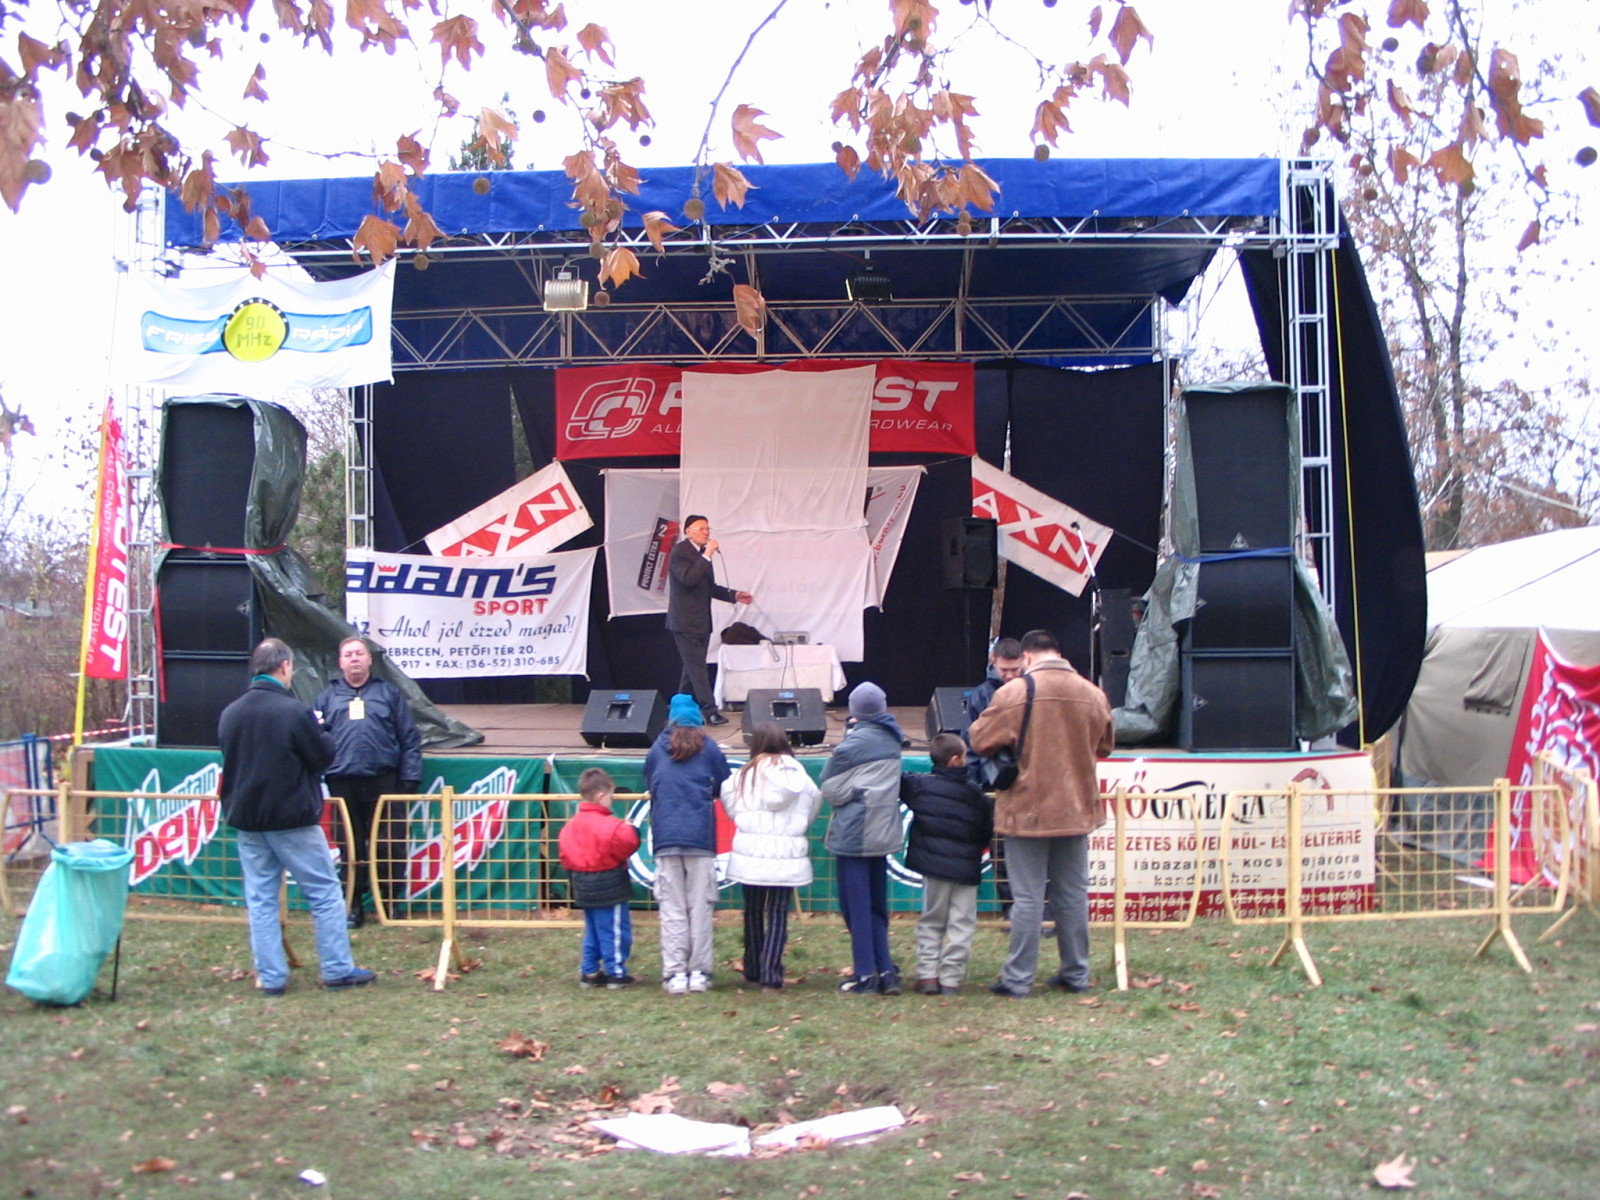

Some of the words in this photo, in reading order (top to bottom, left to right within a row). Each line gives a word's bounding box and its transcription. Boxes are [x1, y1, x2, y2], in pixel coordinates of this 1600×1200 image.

[246, 316, 265, 330] 90
[237, 333, 272, 348] MHz
[658, 524, 668, 537] 2
[973, 491, 1092, 568] AXN
[100, 458, 130, 672] OTEST
[473, 598, 549, 616] SPORT
[378, 615, 430, 638] Ahol
[437, 622, 465, 642] jól
[518, 615, 577, 639] magad!
[449, 643, 491, 657] PETŐFI
[493, 643, 515, 656] TÉR
[518, 645, 537, 655] 20.
[436, 660, 464, 669] FAX:
[1302, 828, 1362, 848] ELTÉRRE
[1243, 851, 1361, 869] kocsejáróra
